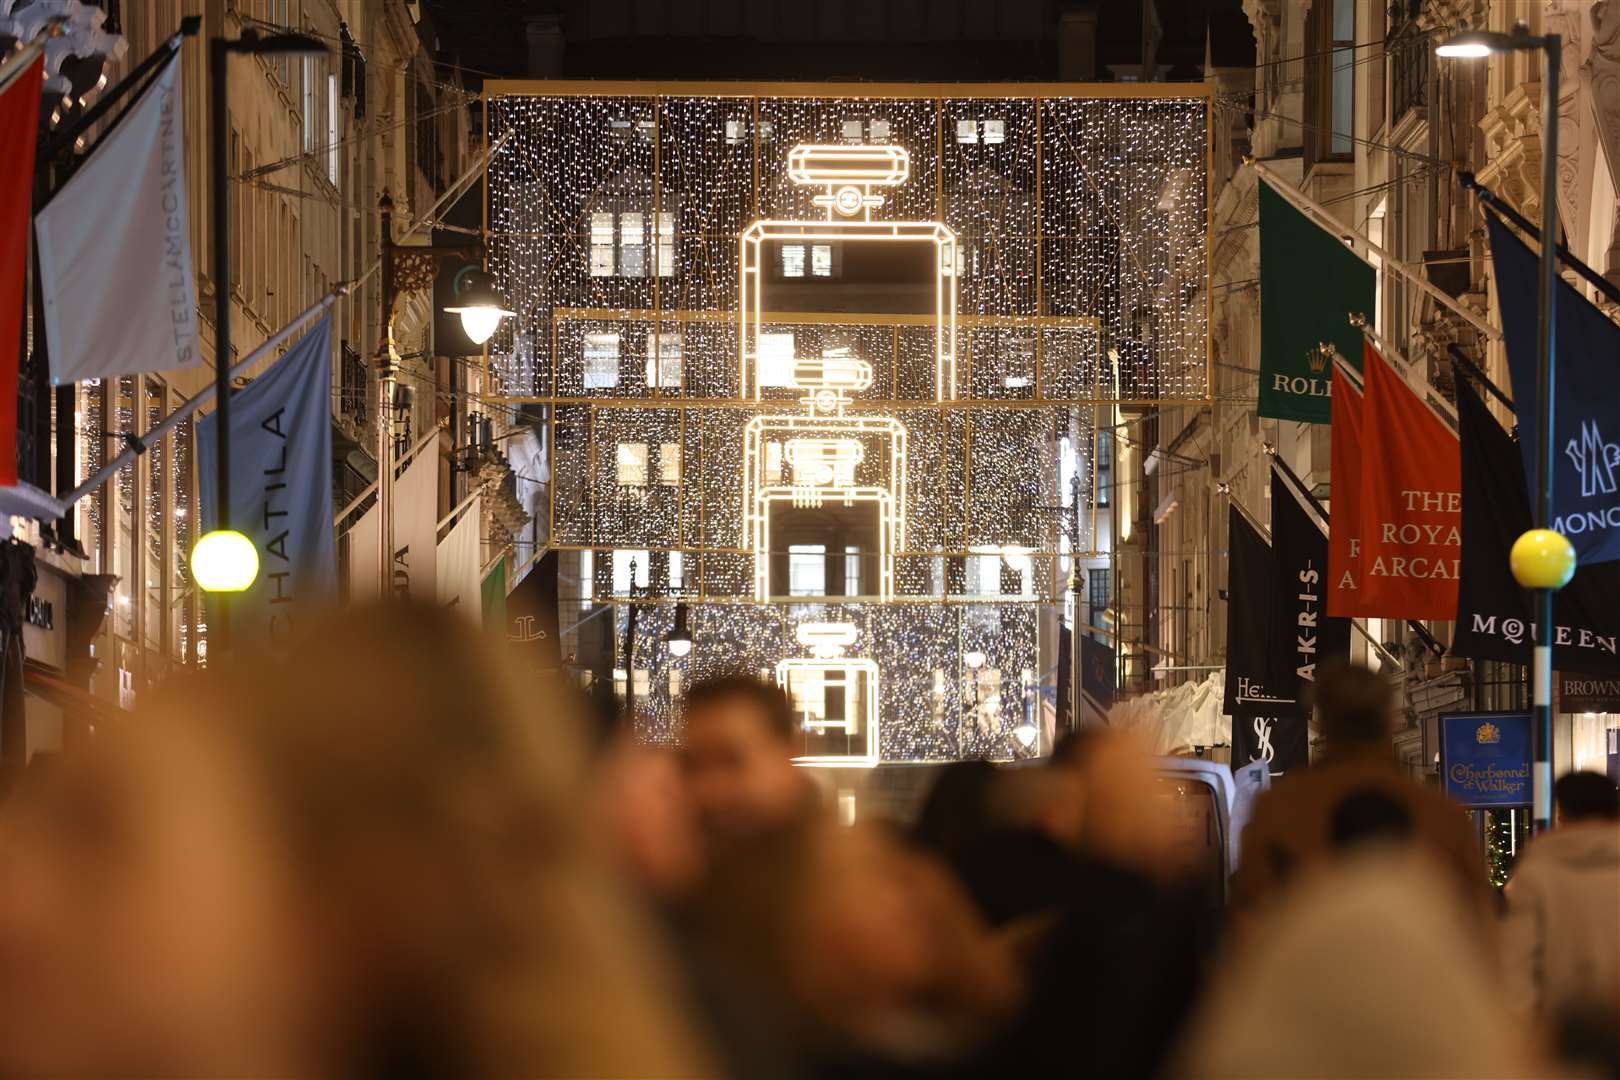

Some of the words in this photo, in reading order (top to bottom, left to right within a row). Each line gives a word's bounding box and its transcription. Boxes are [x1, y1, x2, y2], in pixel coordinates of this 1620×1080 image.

[1401, 490, 1461, 513] THE
[1451, 763, 1529, 784] Charbonnel
[1474, 778, 1525, 795] Walker
